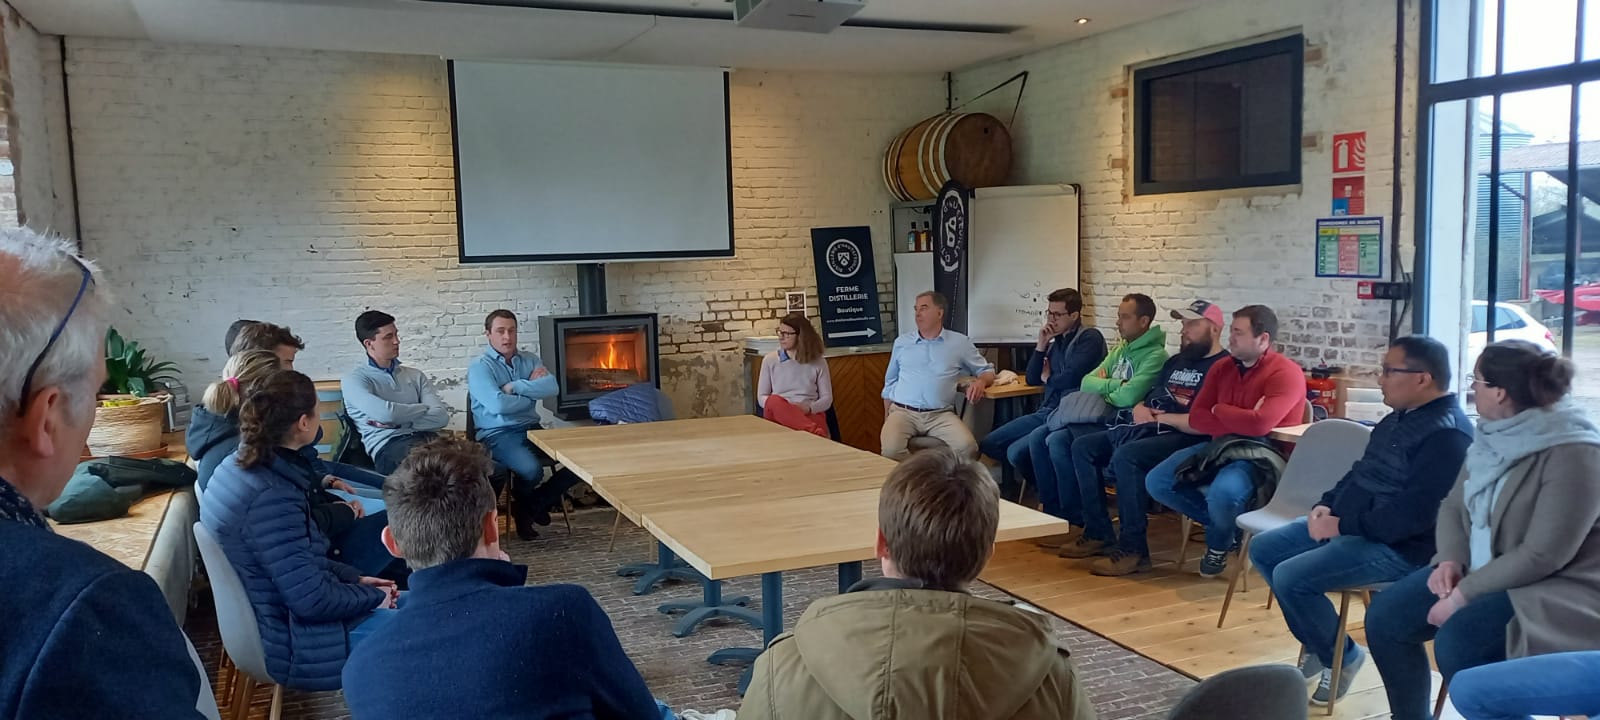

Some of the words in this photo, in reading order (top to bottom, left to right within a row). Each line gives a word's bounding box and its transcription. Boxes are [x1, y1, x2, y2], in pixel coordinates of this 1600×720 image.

[835, 285, 860, 293] FERME
[828, 293, 869, 302] DISTILLERIE
[1169, 369, 1204, 383] HOMMES
